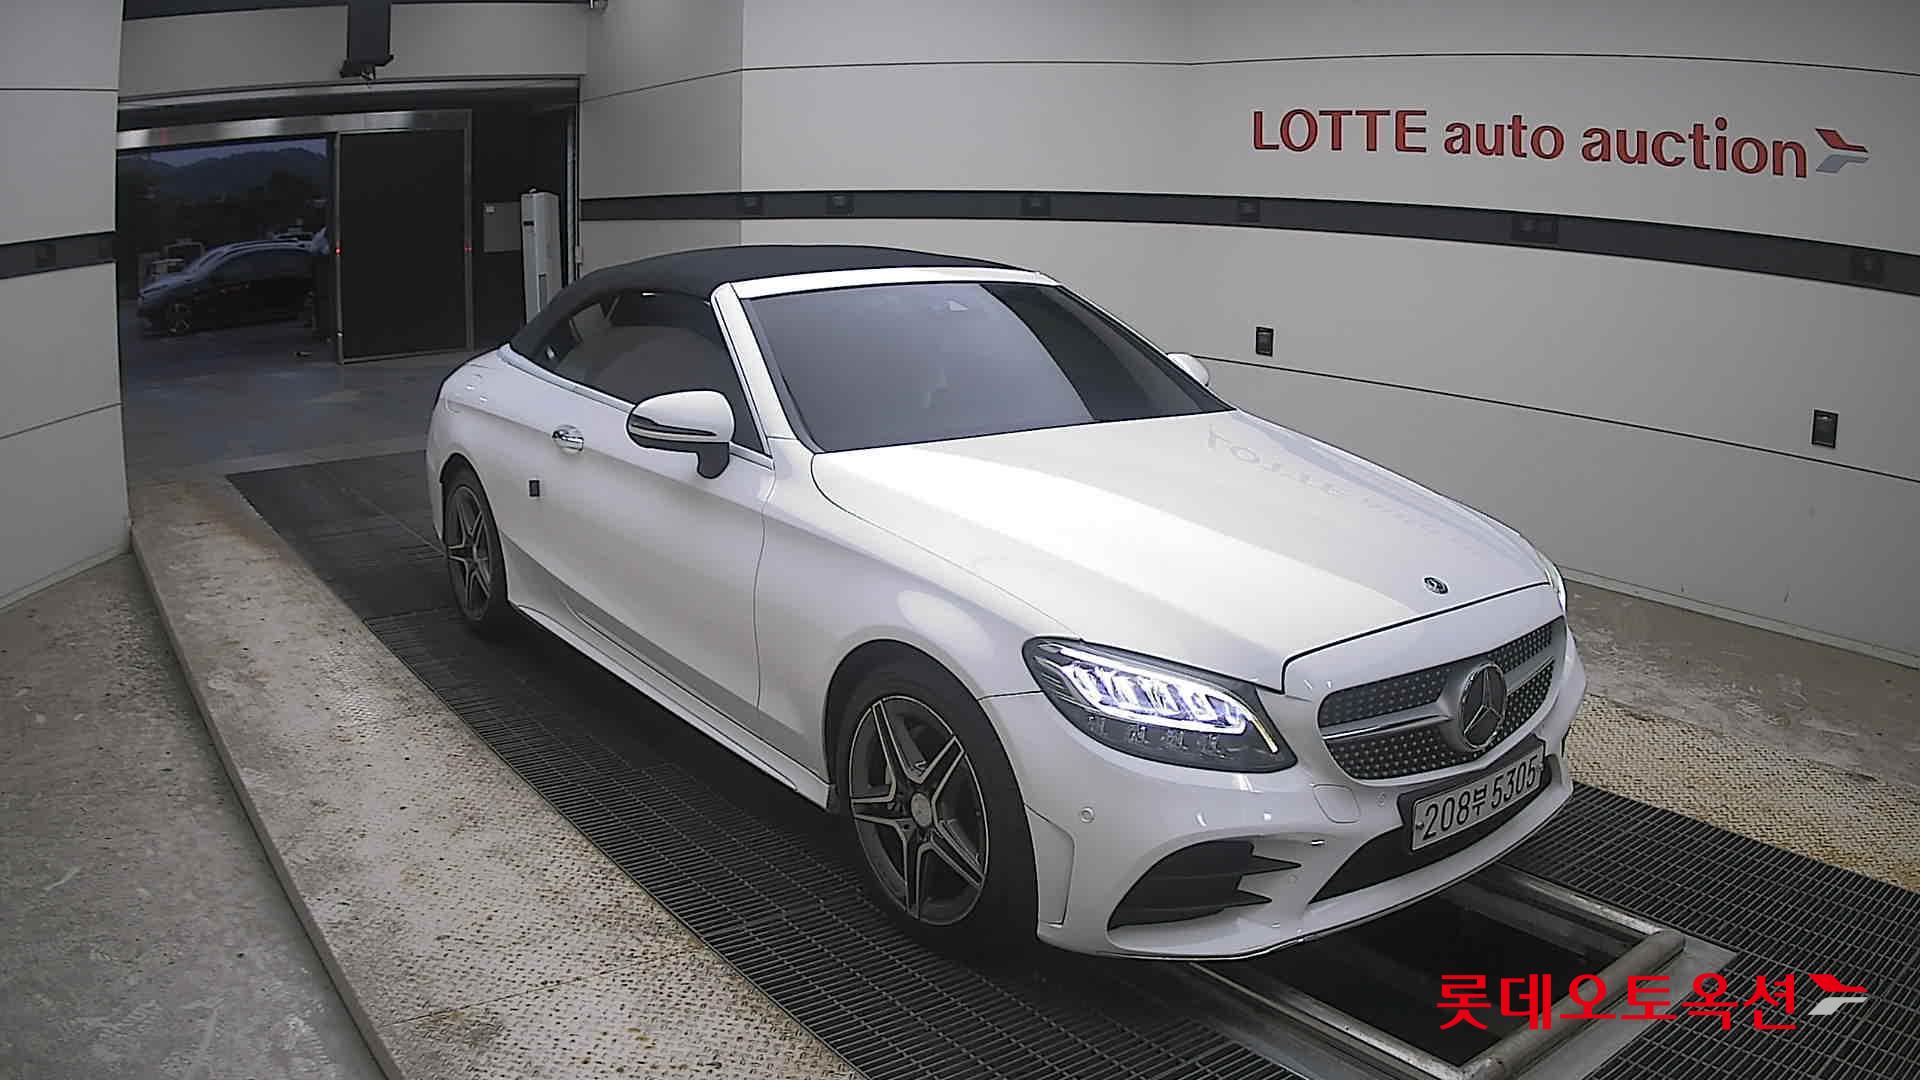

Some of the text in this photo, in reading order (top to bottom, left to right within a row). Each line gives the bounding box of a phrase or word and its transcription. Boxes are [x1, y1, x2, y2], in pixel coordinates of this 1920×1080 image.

[1253, 110, 1808, 178] LOTTE auto auction
[1422, 754, 1538, 841] 208부 5305
